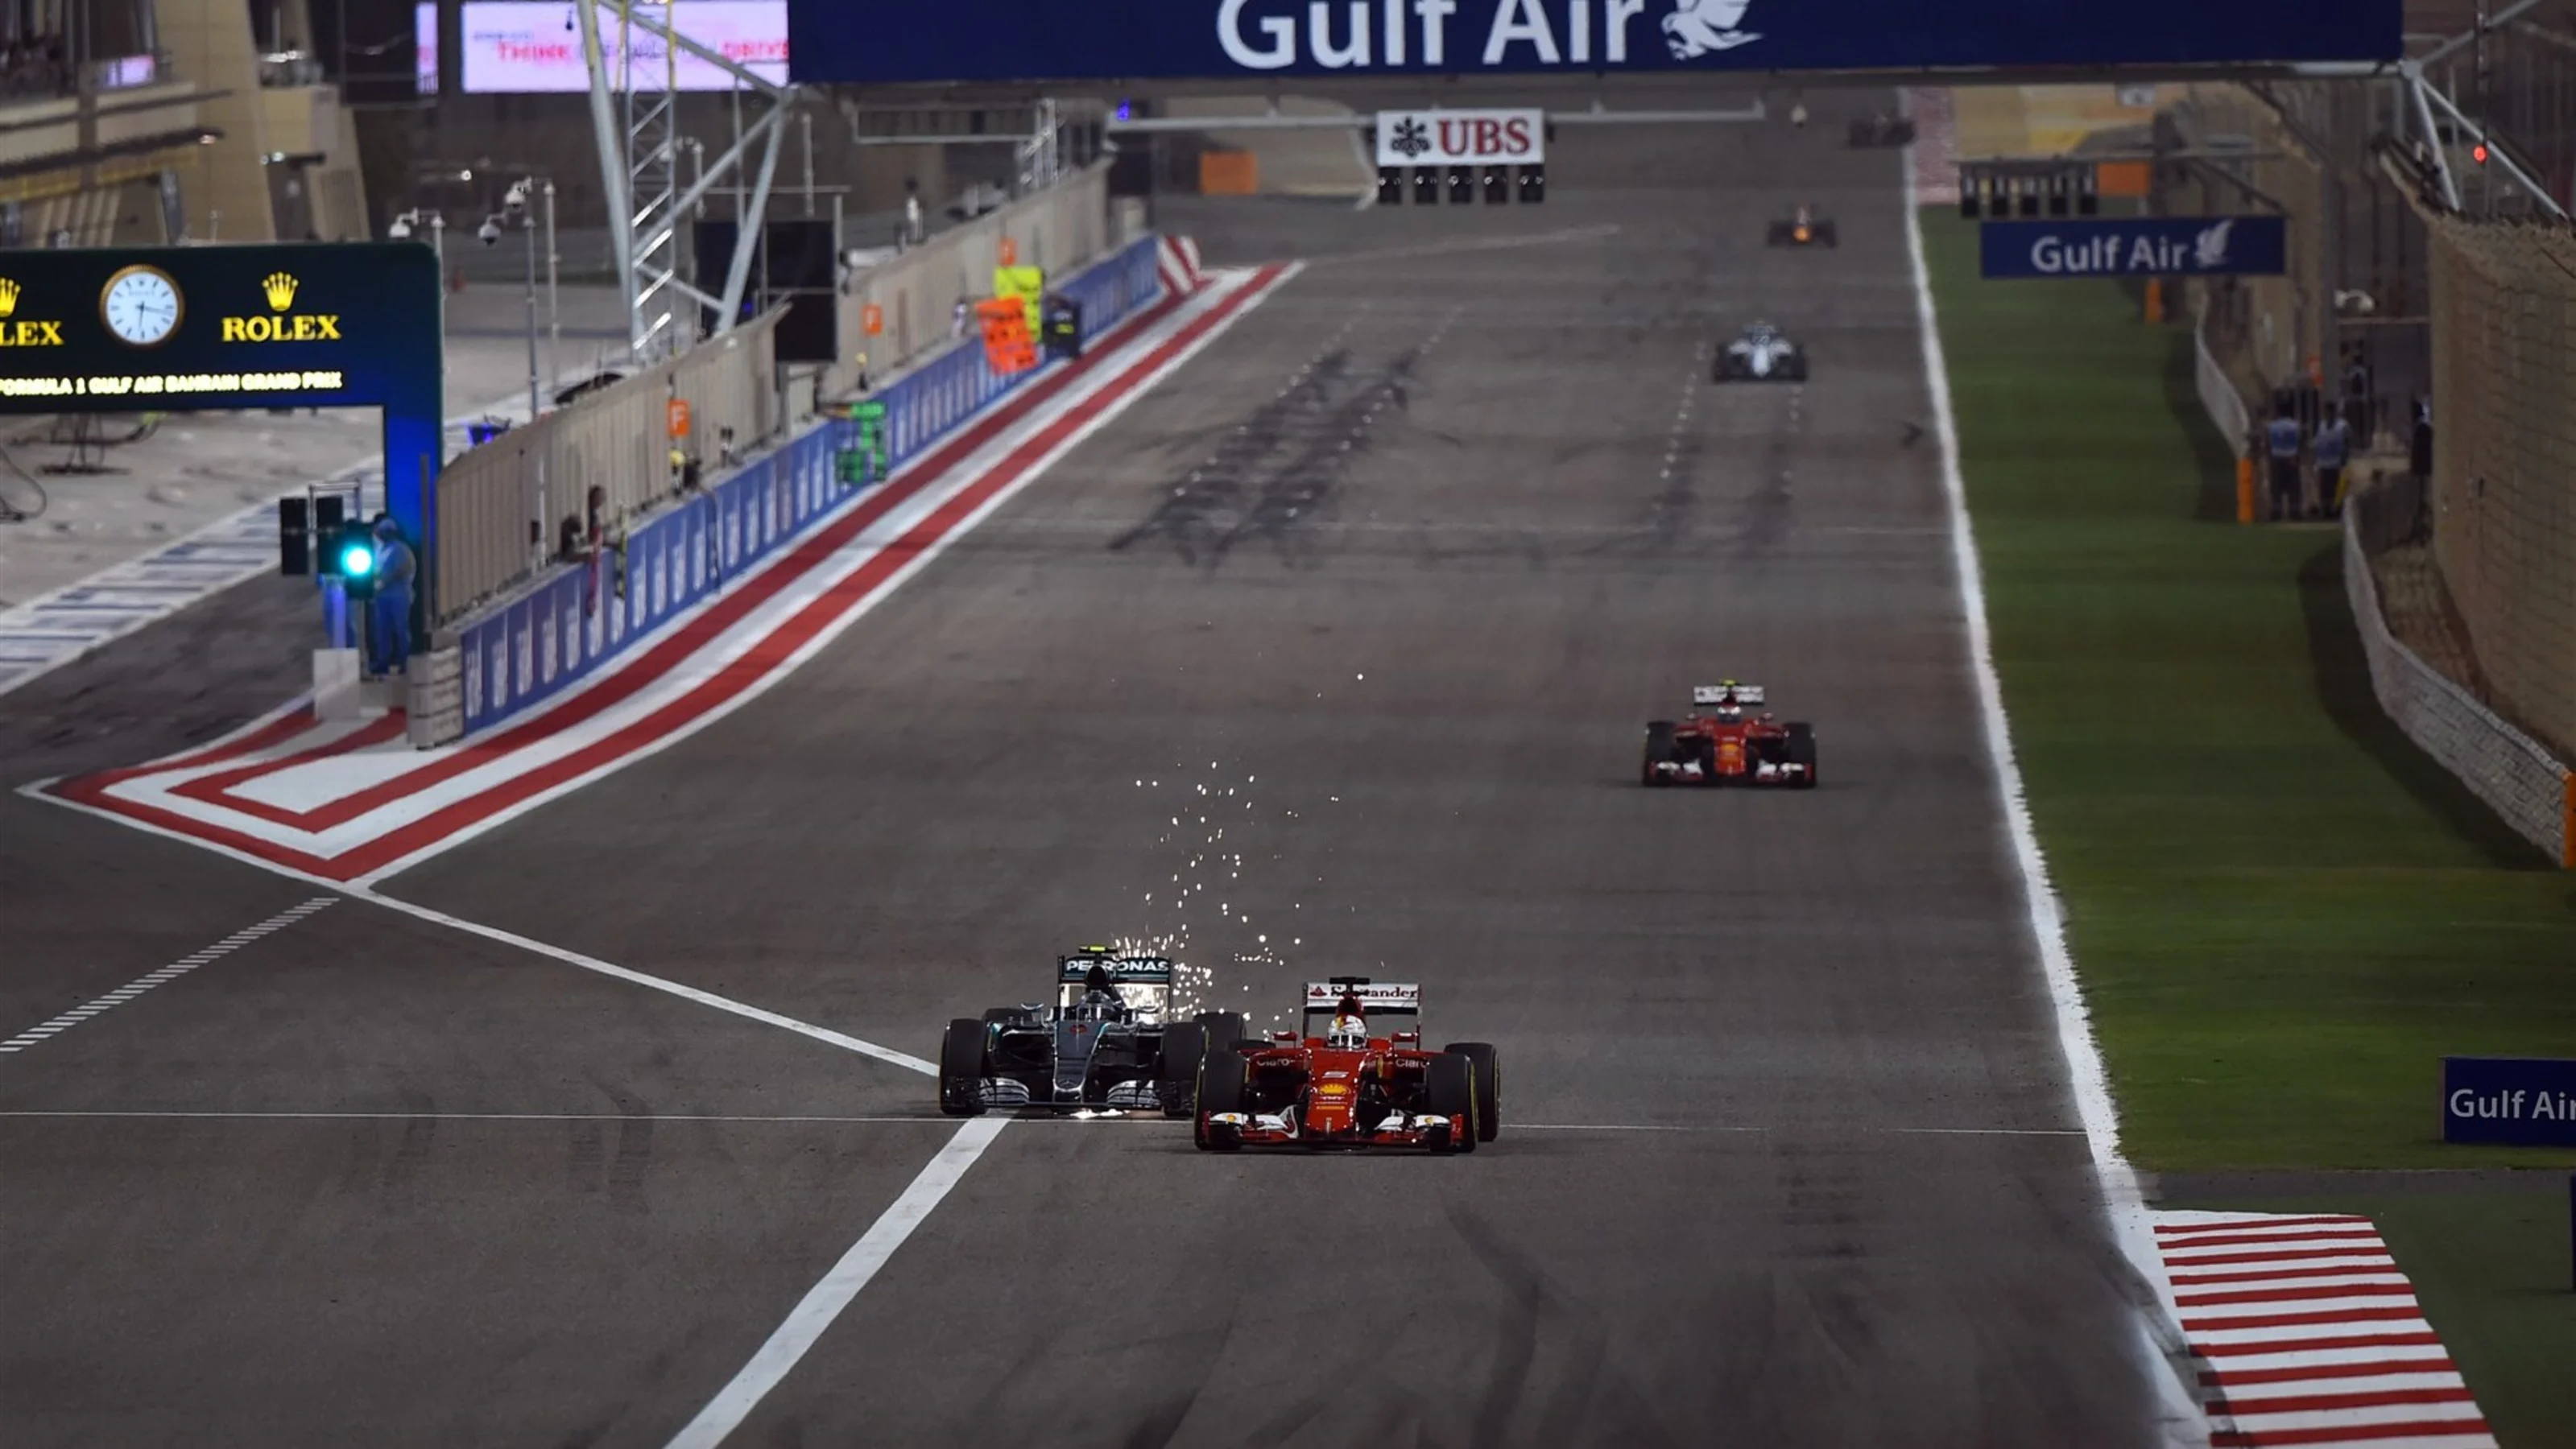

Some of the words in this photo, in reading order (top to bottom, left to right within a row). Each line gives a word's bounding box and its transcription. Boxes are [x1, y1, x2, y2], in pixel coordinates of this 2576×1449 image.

[1217, 0, 1457, 69] Gulf
[1482, 0, 1645, 64] Air
[1438, 118, 1531, 156] UBS
[2031, 236, 2122, 273] Gulf
[2128, 241, 2189, 270] Air
[0, 320, 64, 347] LEX
[221, 315, 341, 342] ROLEX
[76, 377, 85, 394] 1
[88, 375, 133, 394] GULF
[133, 374, 163, 394] AIR
[241, 372, 302, 391] GRAND
[1065, 959, 1170, 972] PERONAS
[2450, 1088, 2526, 1119] Gulf
[2531, 1091, 2576, 1121] Air
